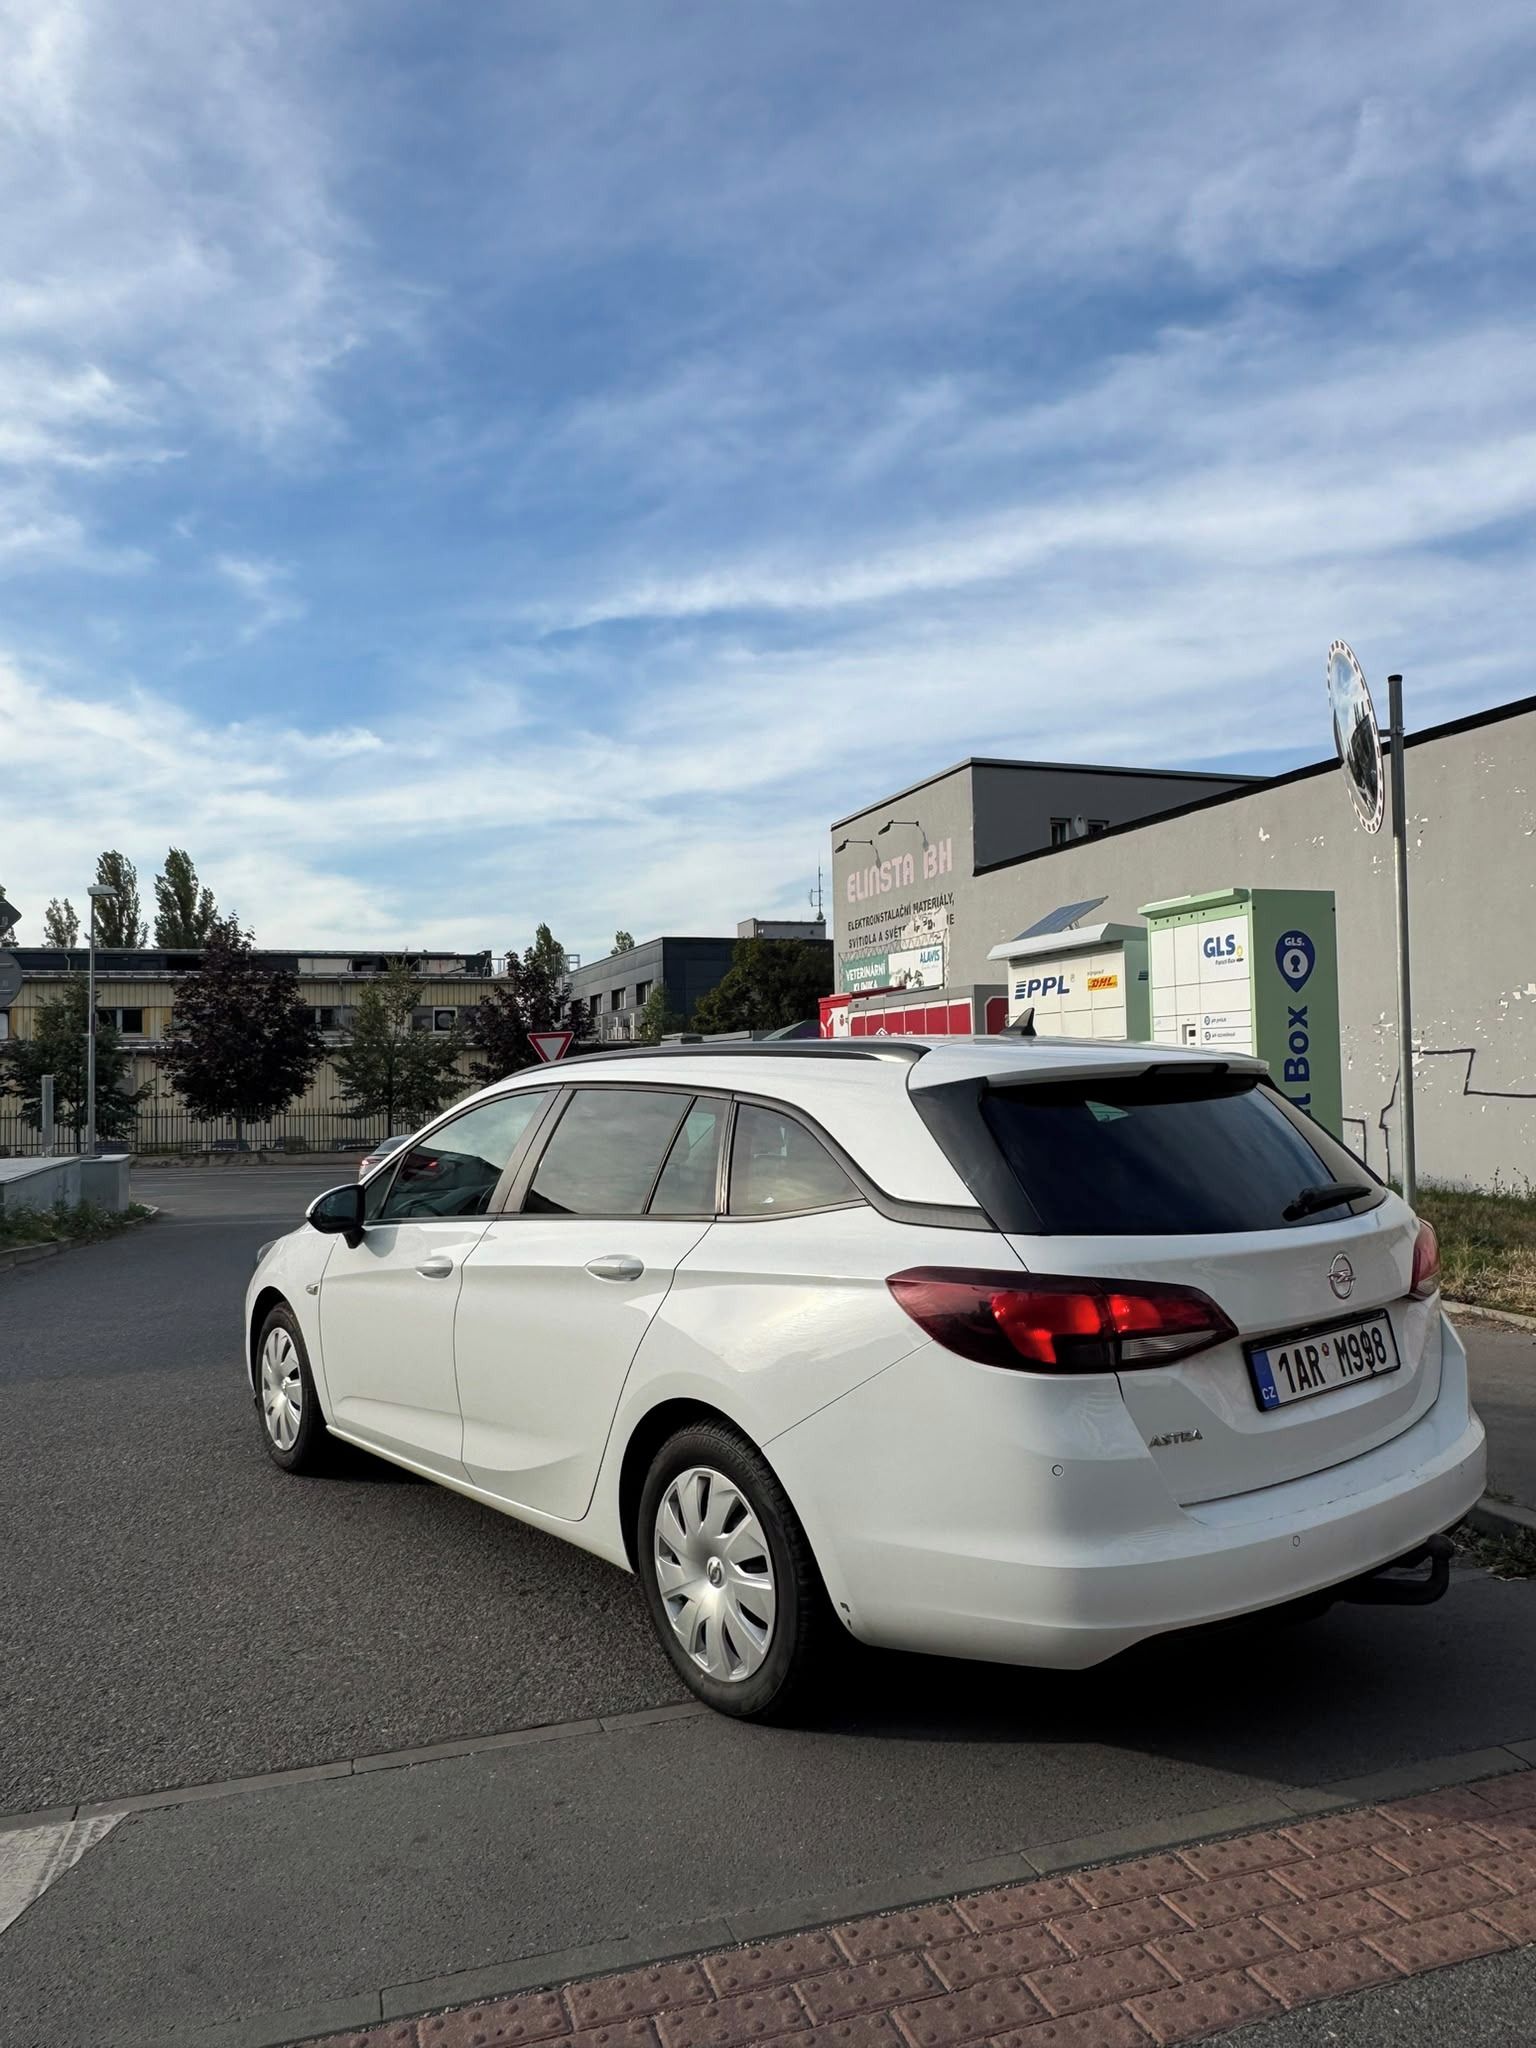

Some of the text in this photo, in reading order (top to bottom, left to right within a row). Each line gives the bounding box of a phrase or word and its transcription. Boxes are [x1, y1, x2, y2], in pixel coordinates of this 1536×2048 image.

[847, 838, 953, 903] ELINSTA BH
[847, 902, 912, 932] ELEKTROINSTALAČNÍ
[878, 931, 884, 942] A
[846, 962, 886, 982] VETERINÁRNÍ
[1090, 976, 1114, 988] DHL
[1027, 975, 1070, 998] PPL
[1278, 1327, 1387, 1394] 1AR M998
[1261, 1386, 1277, 1400] CZ
[1149, 1428, 1203, 1448] ASTRA
